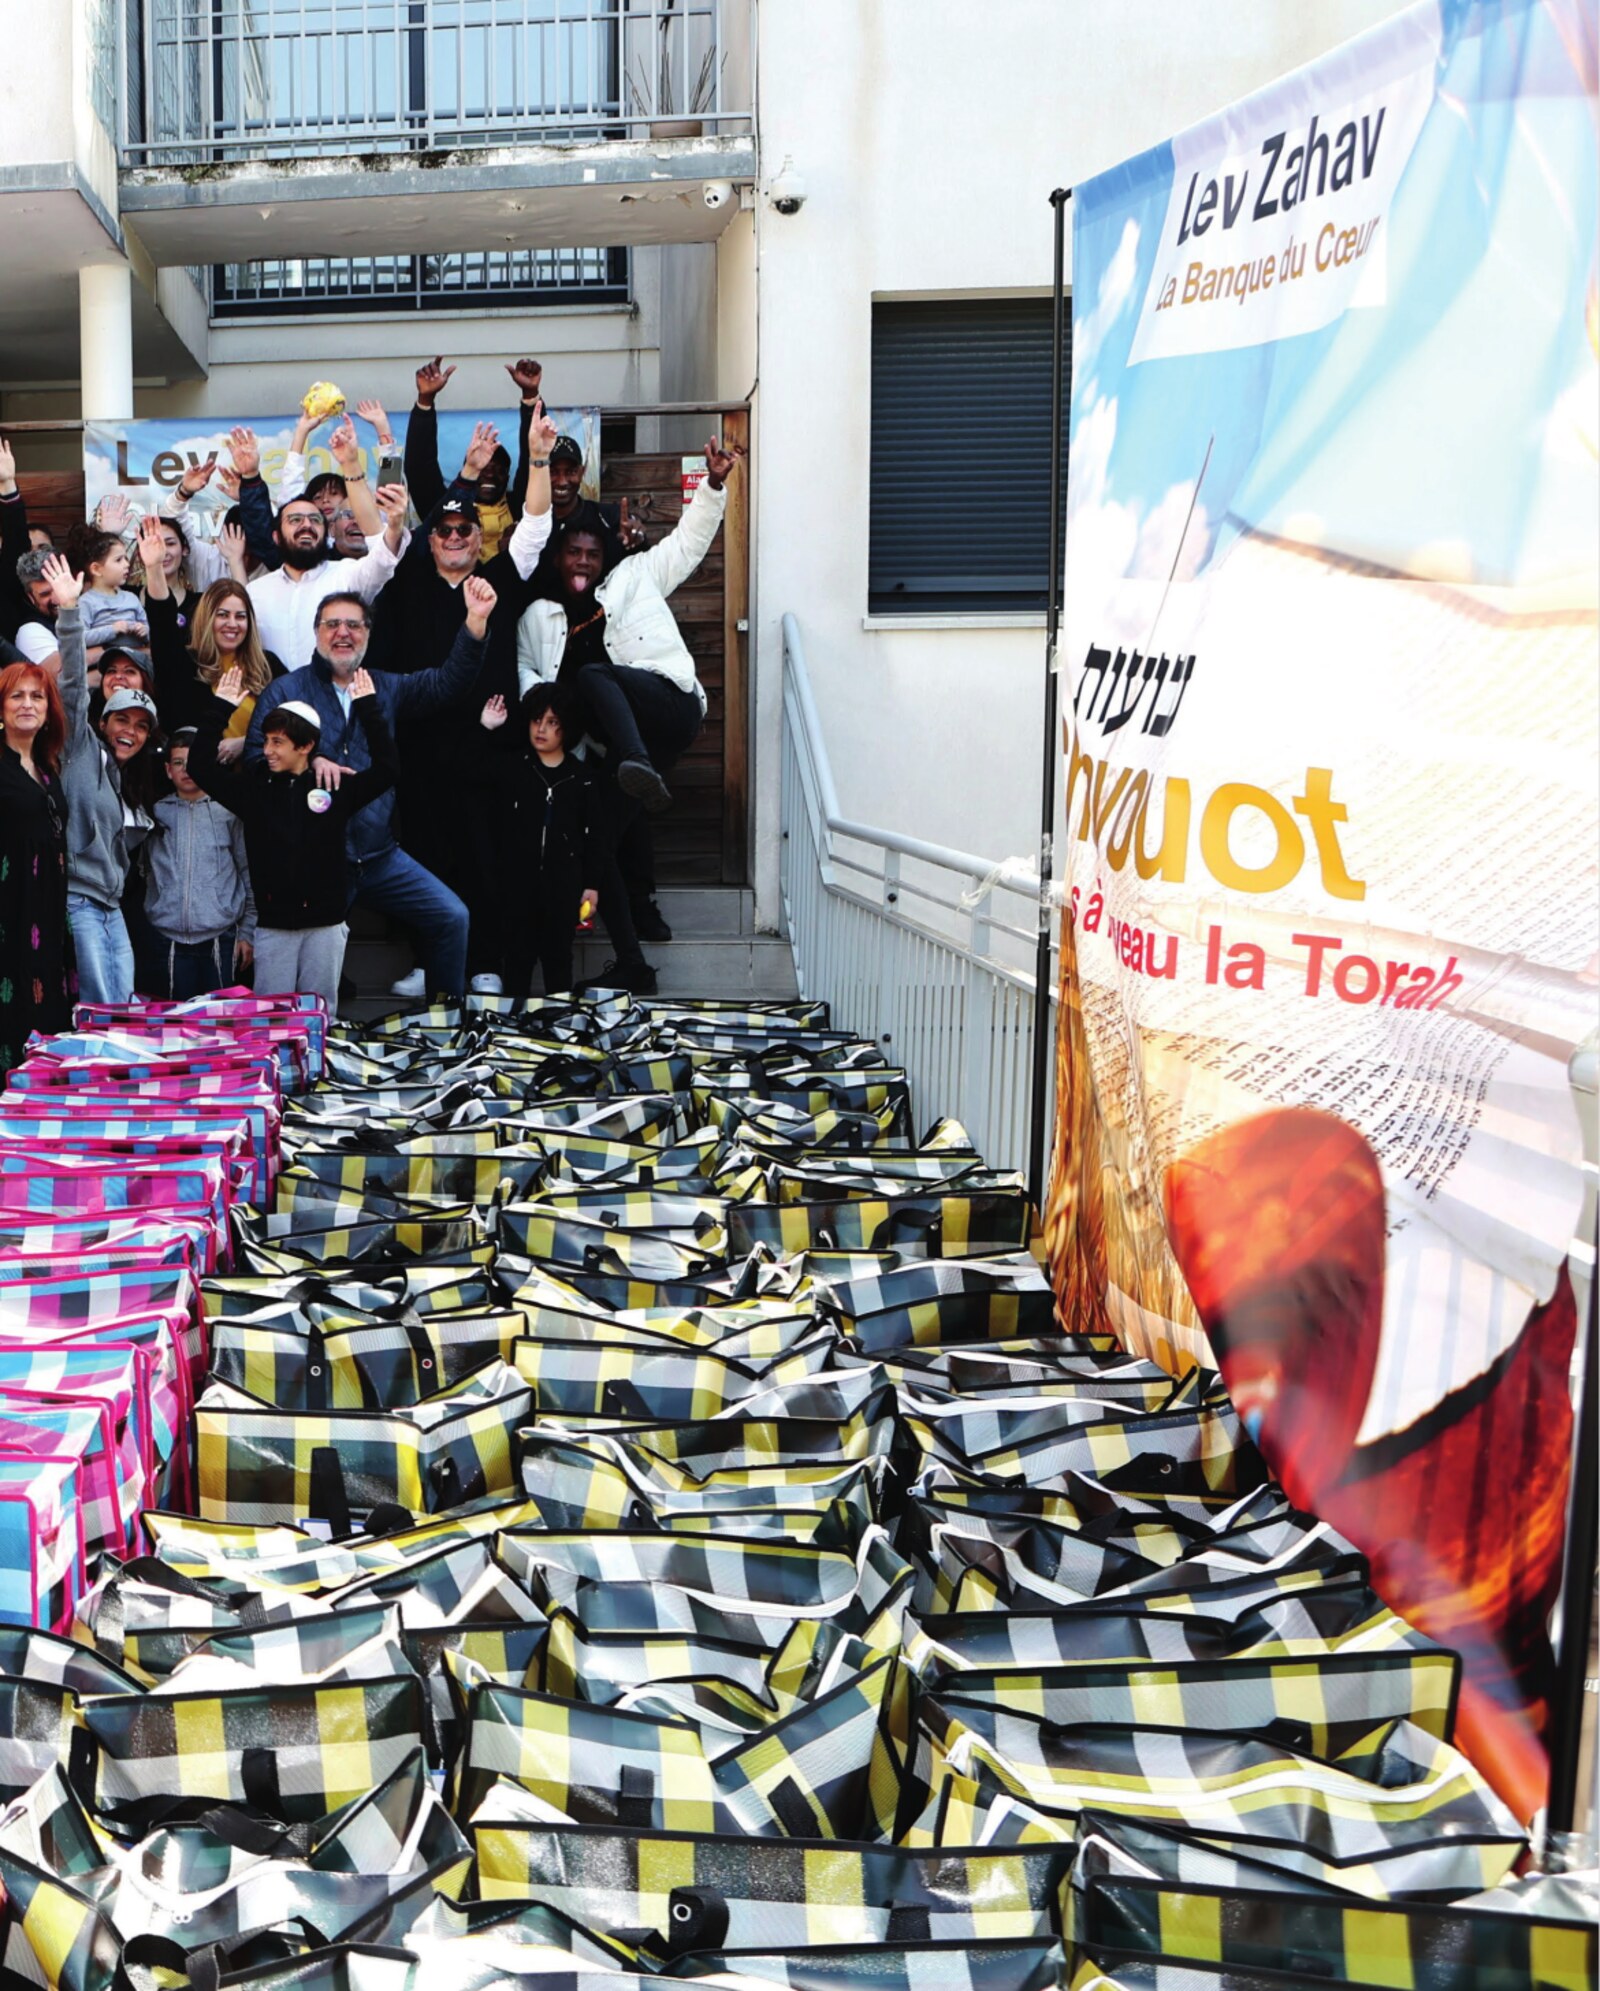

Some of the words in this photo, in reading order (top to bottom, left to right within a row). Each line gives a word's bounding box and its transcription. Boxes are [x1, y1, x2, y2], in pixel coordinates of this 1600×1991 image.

[1176, 170, 1249, 247] Lev
[1252, 107, 1387, 222] Zahav
[1181, 254, 1276, 305] Banque
[1279, 235, 1307, 283] du
[1316, 214, 1381, 273] Cœur
[1205, 925, 1265, 990] la
[1292, 933, 1464, 1012] Torah
